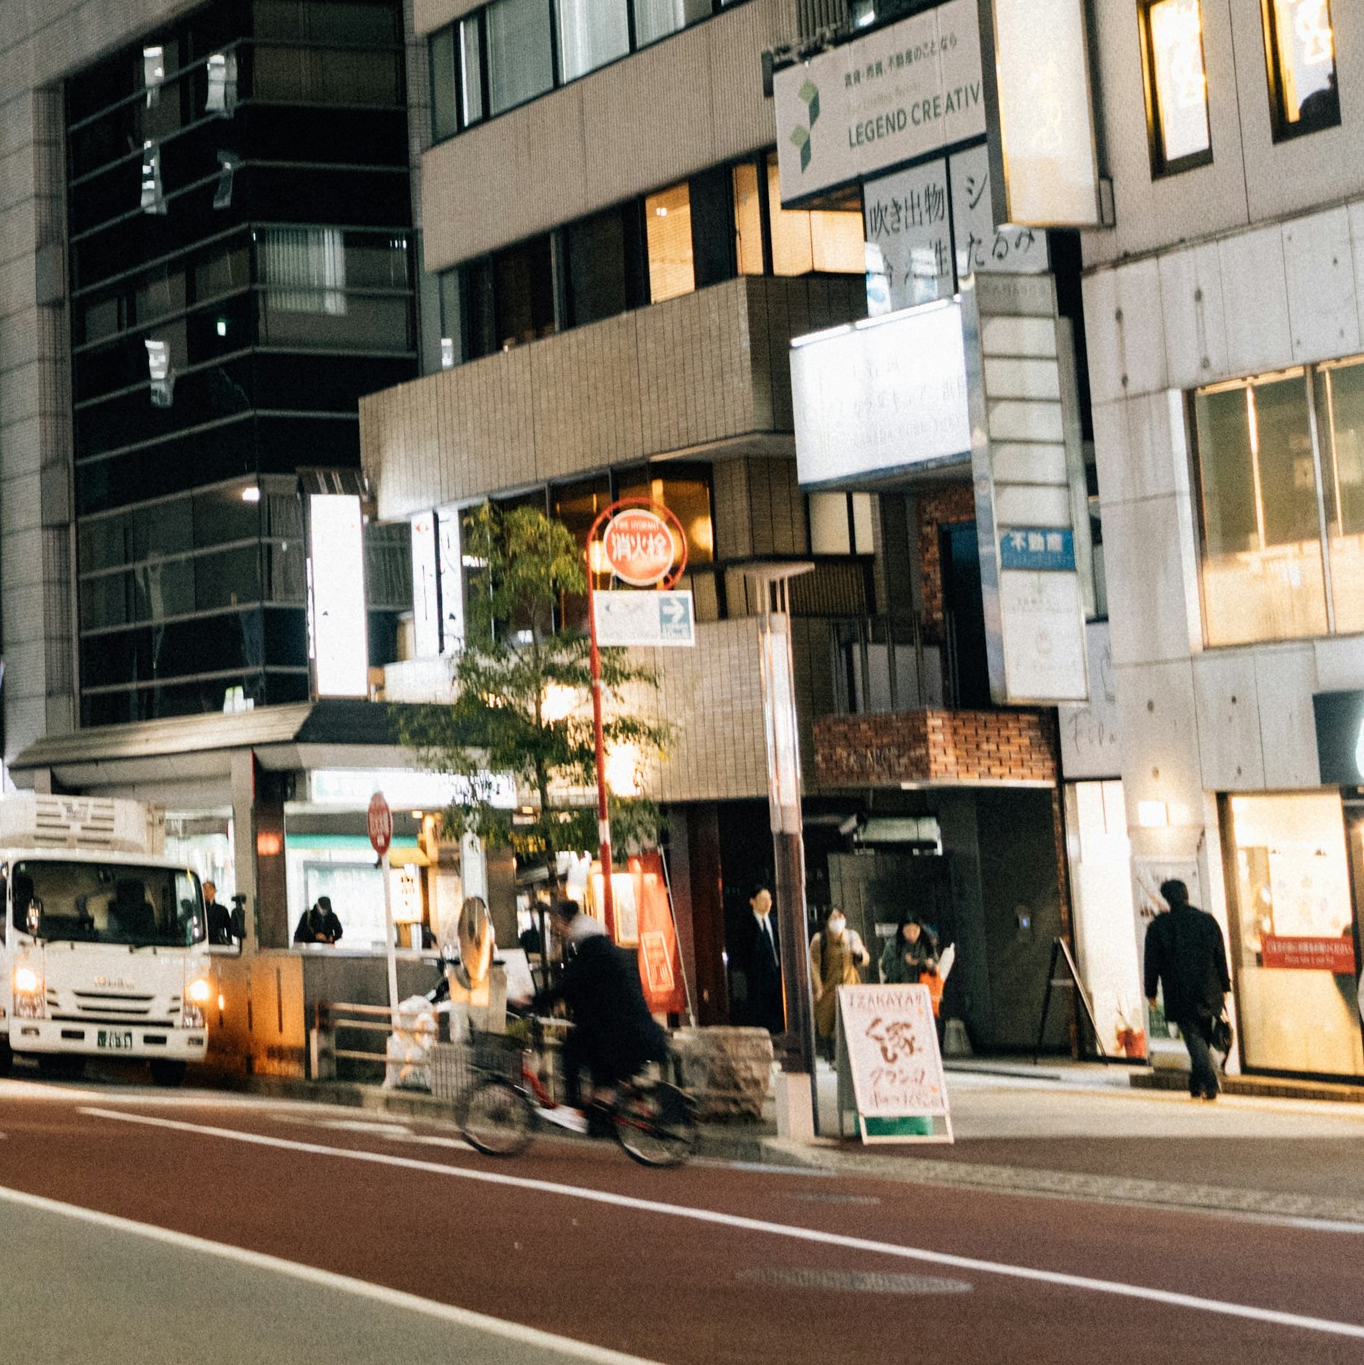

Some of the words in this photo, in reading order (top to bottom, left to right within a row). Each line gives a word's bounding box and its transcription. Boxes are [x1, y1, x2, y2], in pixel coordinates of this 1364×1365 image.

[848, 108, 908, 149] LEGEND
[869, 182, 946, 242] 吹き出物
[611, 531, 668, 563] 消火栓
